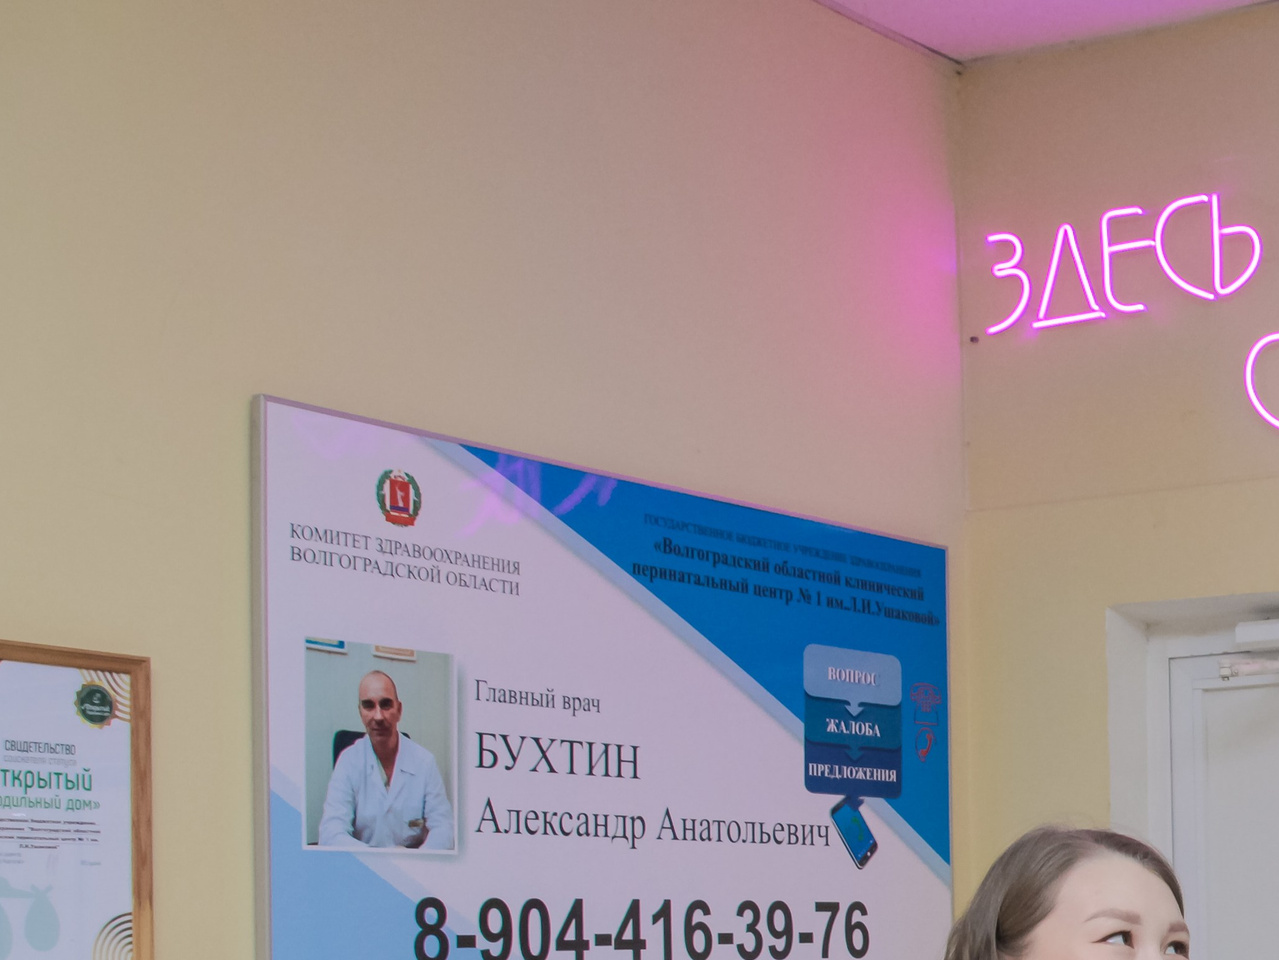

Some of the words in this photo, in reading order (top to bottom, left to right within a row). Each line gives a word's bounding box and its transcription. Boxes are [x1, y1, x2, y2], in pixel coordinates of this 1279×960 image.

[986, 193, 1261, 335] ЗДЕСЬ
[290, 523, 371, 552] КОМИТЕТ
[375, 537, 521, 576] ЗДРАВООХРАНЕНИЯ
[290, 546, 441, 584] ВОЛГОГРАДСКОЙ
[446, 570, 520, 597] ОБЛАСТИ
[654, 537, 770, 573] «Волгоградский
[774, 558, 841, 586] областной
[844, 574, 924, 601] клинический
[632, 561, 749, 594] перинатальный
[753, 579, 793, 604] центр
[797, 586, 812, 603] №
[816, 591, 822, 605] 1
[474, 679, 556, 709] Главный
[562, 694, 601, 717] врач
[828, 667, 878, 686] ВОПРОС
[5, 740, 76, 755] СВИДЕТЕЛЬСТВО
[826, 718, 881, 737] ЖАЛОБА
[475, 731, 641, 779] БУХТИН
[808, 763, 897, 782] ПРЕДЛОЖЕНИЯ
[475, 797, 646, 849] Александр
[656, 807, 831, 847] Анатольевич
